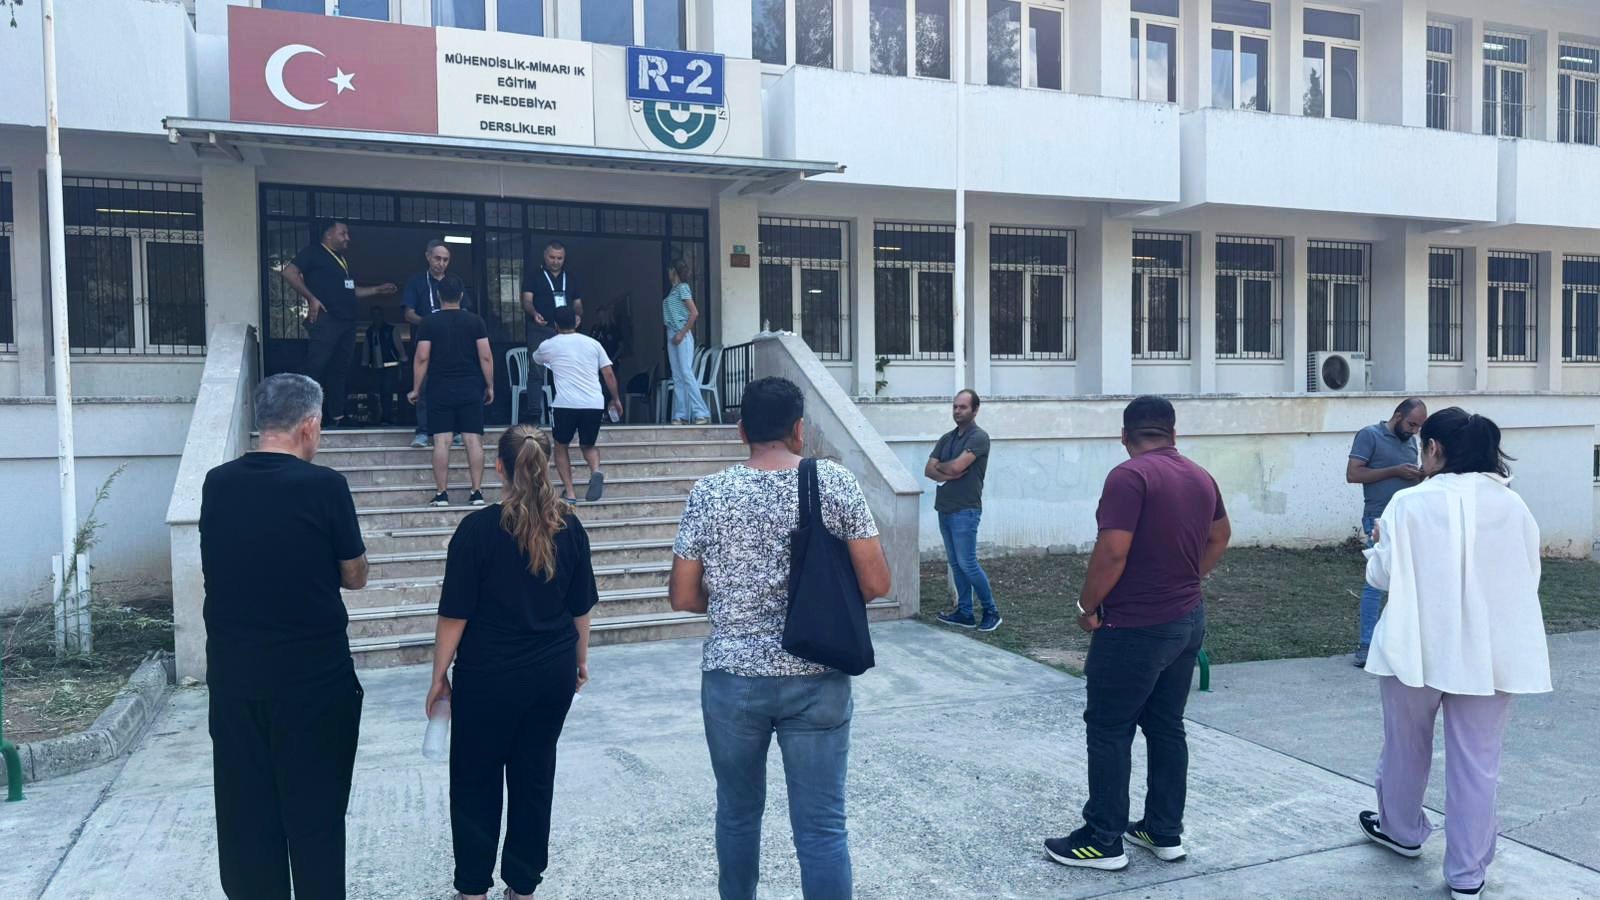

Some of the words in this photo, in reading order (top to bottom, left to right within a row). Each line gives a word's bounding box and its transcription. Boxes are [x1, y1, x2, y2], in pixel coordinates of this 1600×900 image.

[497, 76, 537, 90] EĞİTİM
[638, 54, 713, 95] R-2
[475, 93, 557, 111] FEN-EDEBİYAT
[480, 120, 556, 136] DERSLİKLERİ
